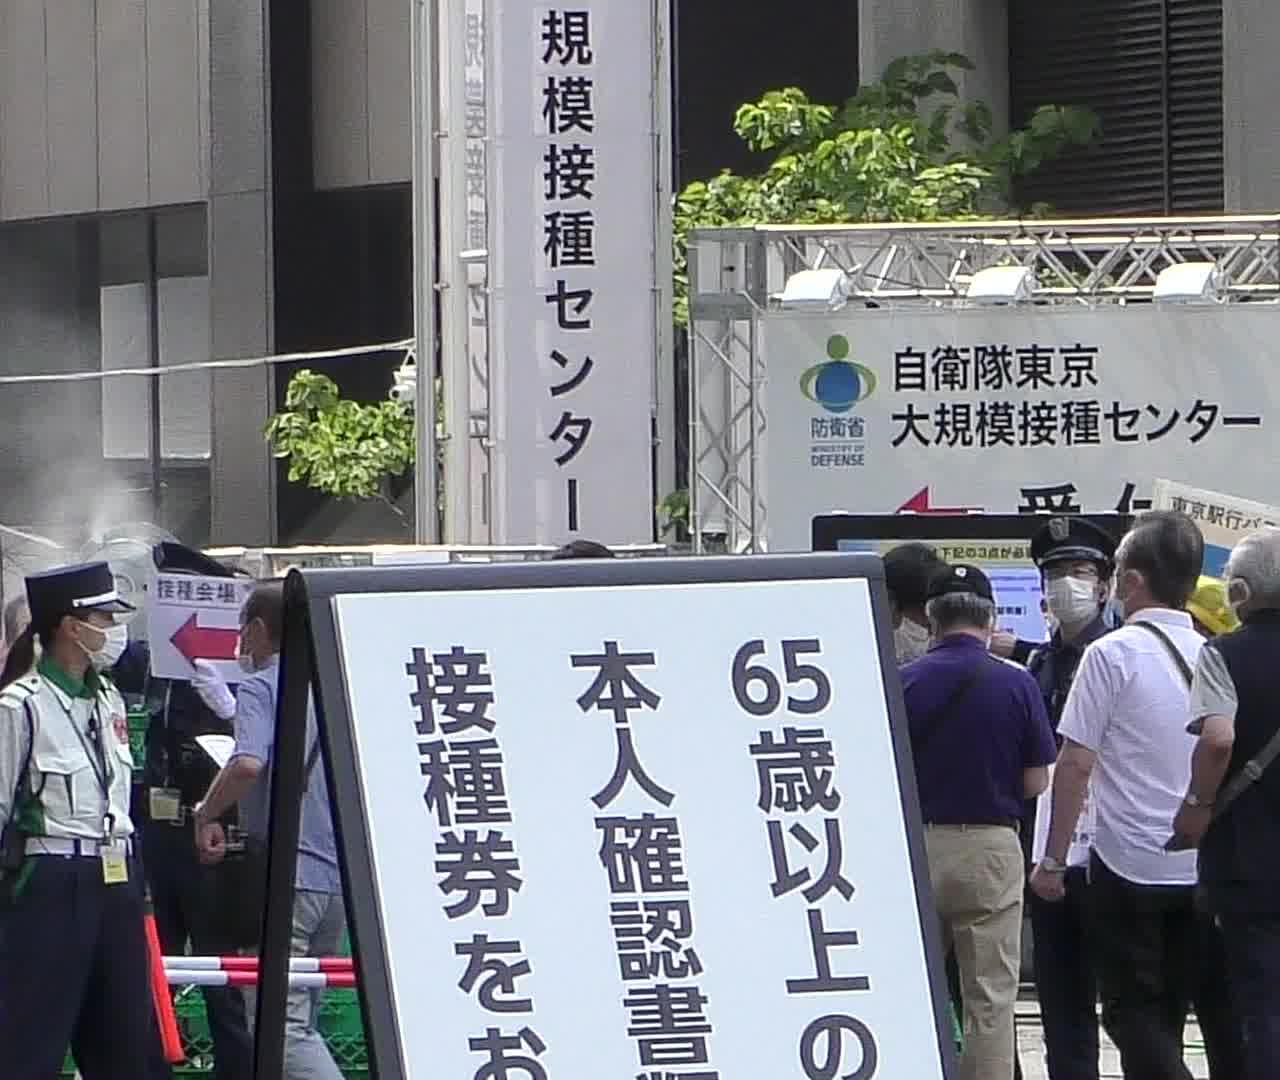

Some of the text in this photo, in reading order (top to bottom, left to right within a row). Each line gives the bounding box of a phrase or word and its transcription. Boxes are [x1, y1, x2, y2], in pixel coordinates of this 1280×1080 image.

[541, 10, 596, 532] 規模接種センター
[894, 344, 1099, 392] 自衛隊東京
[811, 416, 865, 438] 防衛省
[891, 399, 1261, 447] 大規模接種センター
[811, 454, 865, 467] DEFENSE
